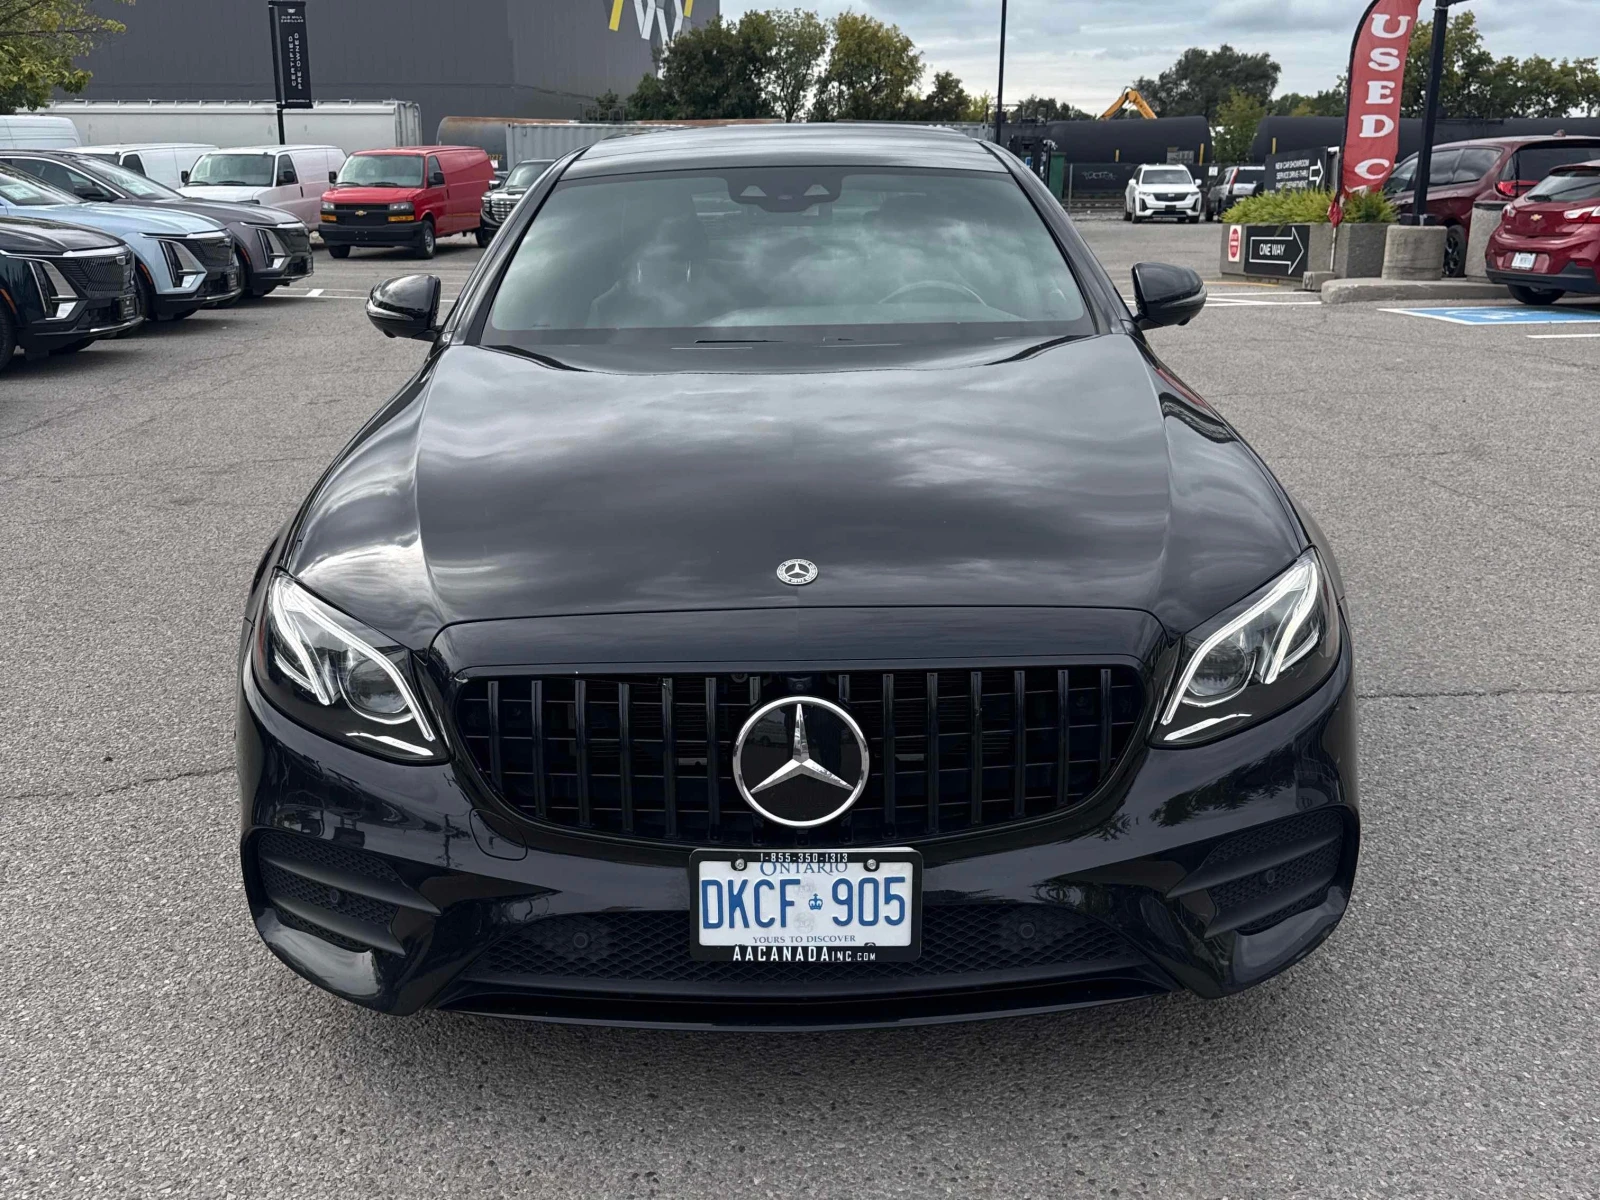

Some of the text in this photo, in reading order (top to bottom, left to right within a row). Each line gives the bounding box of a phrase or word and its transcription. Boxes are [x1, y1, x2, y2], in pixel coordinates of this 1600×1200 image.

[288, 36, 296, 86] CERTIFIED
[1359, 13, 1411, 138] USED
[1259, 243, 1286, 256] ONE WAY
[760, 852, 848, 863] 1-855-350-1313
[701, 876, 906, 929] DKCF 905
[752, 934, 857, 944] YOURS TO DISCOVER
